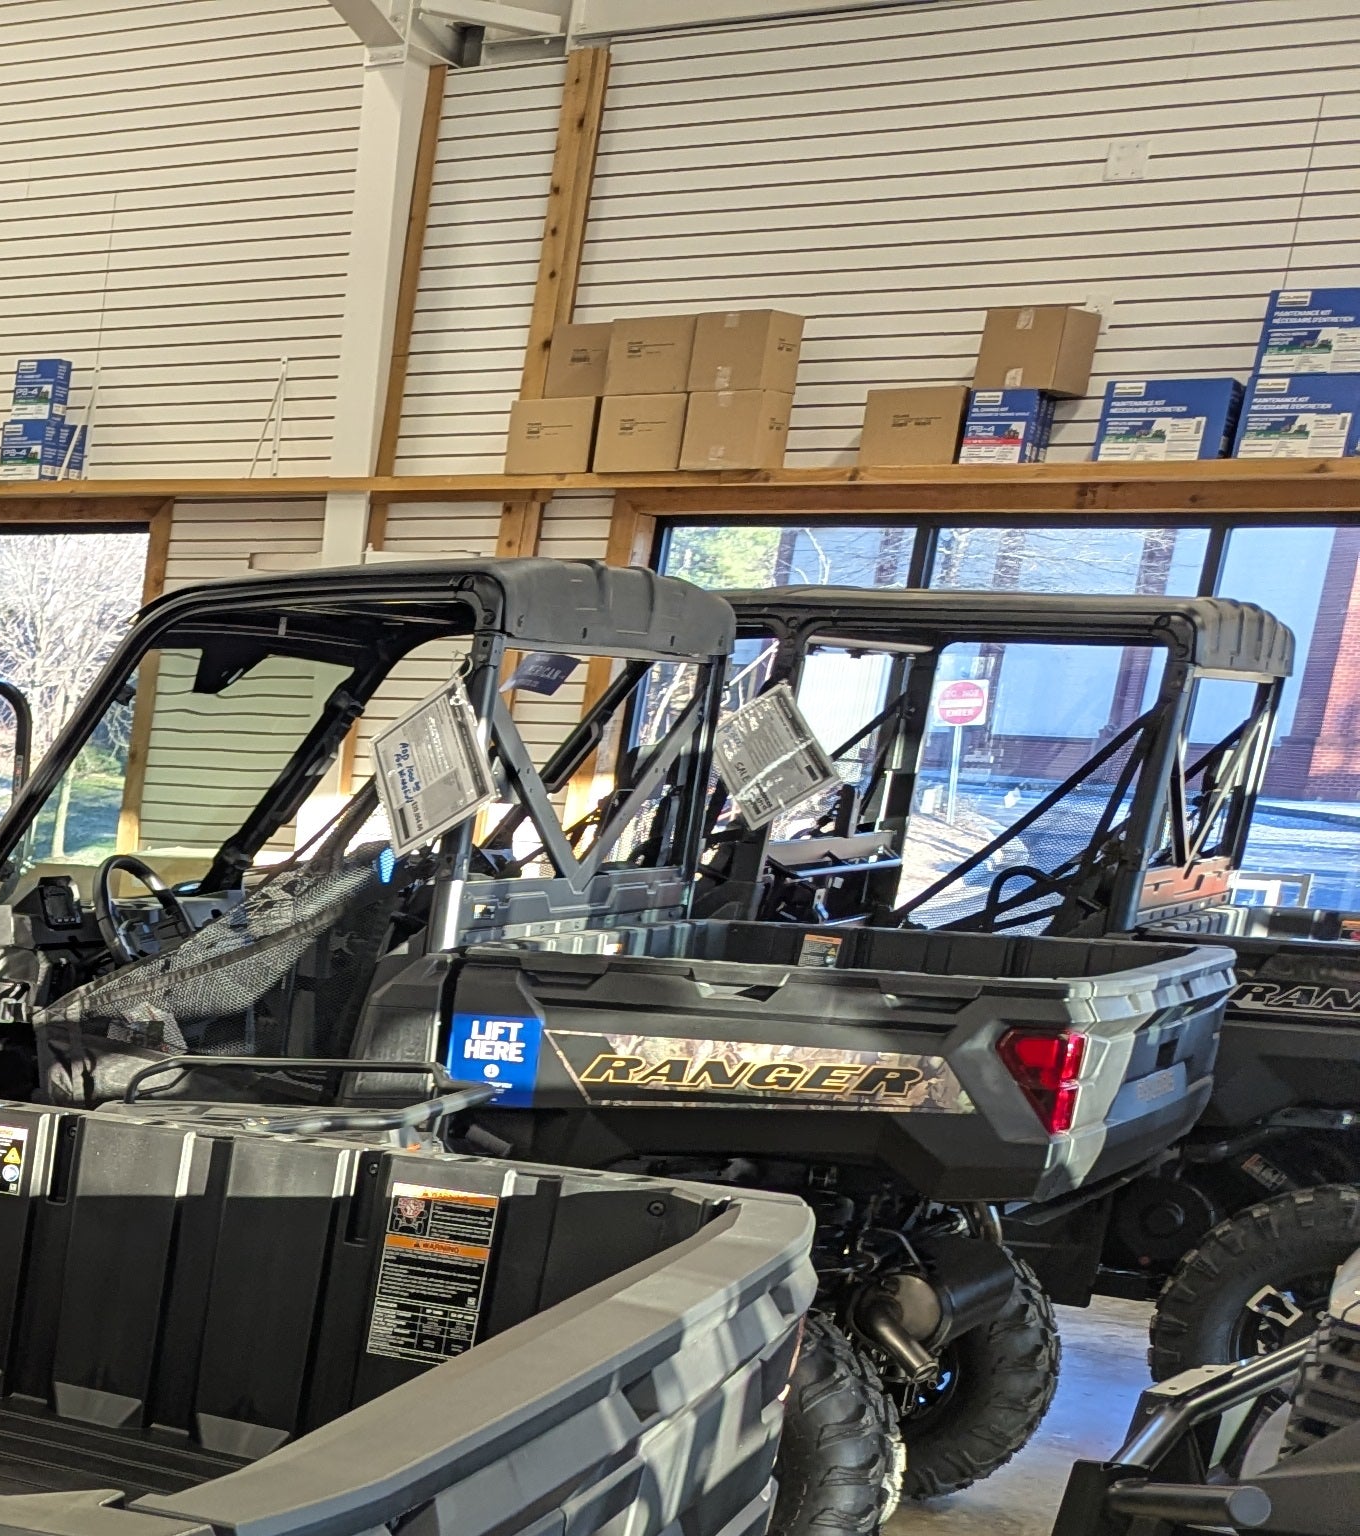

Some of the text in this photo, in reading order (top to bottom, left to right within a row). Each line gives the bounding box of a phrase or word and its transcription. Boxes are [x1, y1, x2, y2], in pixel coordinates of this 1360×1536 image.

[470, 1020, 524, 1041] LIFT
[463, 1039, 526, 1062] HERE
[580, 1053, 924, 1099] RANGER
[422, 1242, 460, 1254] WARNING
